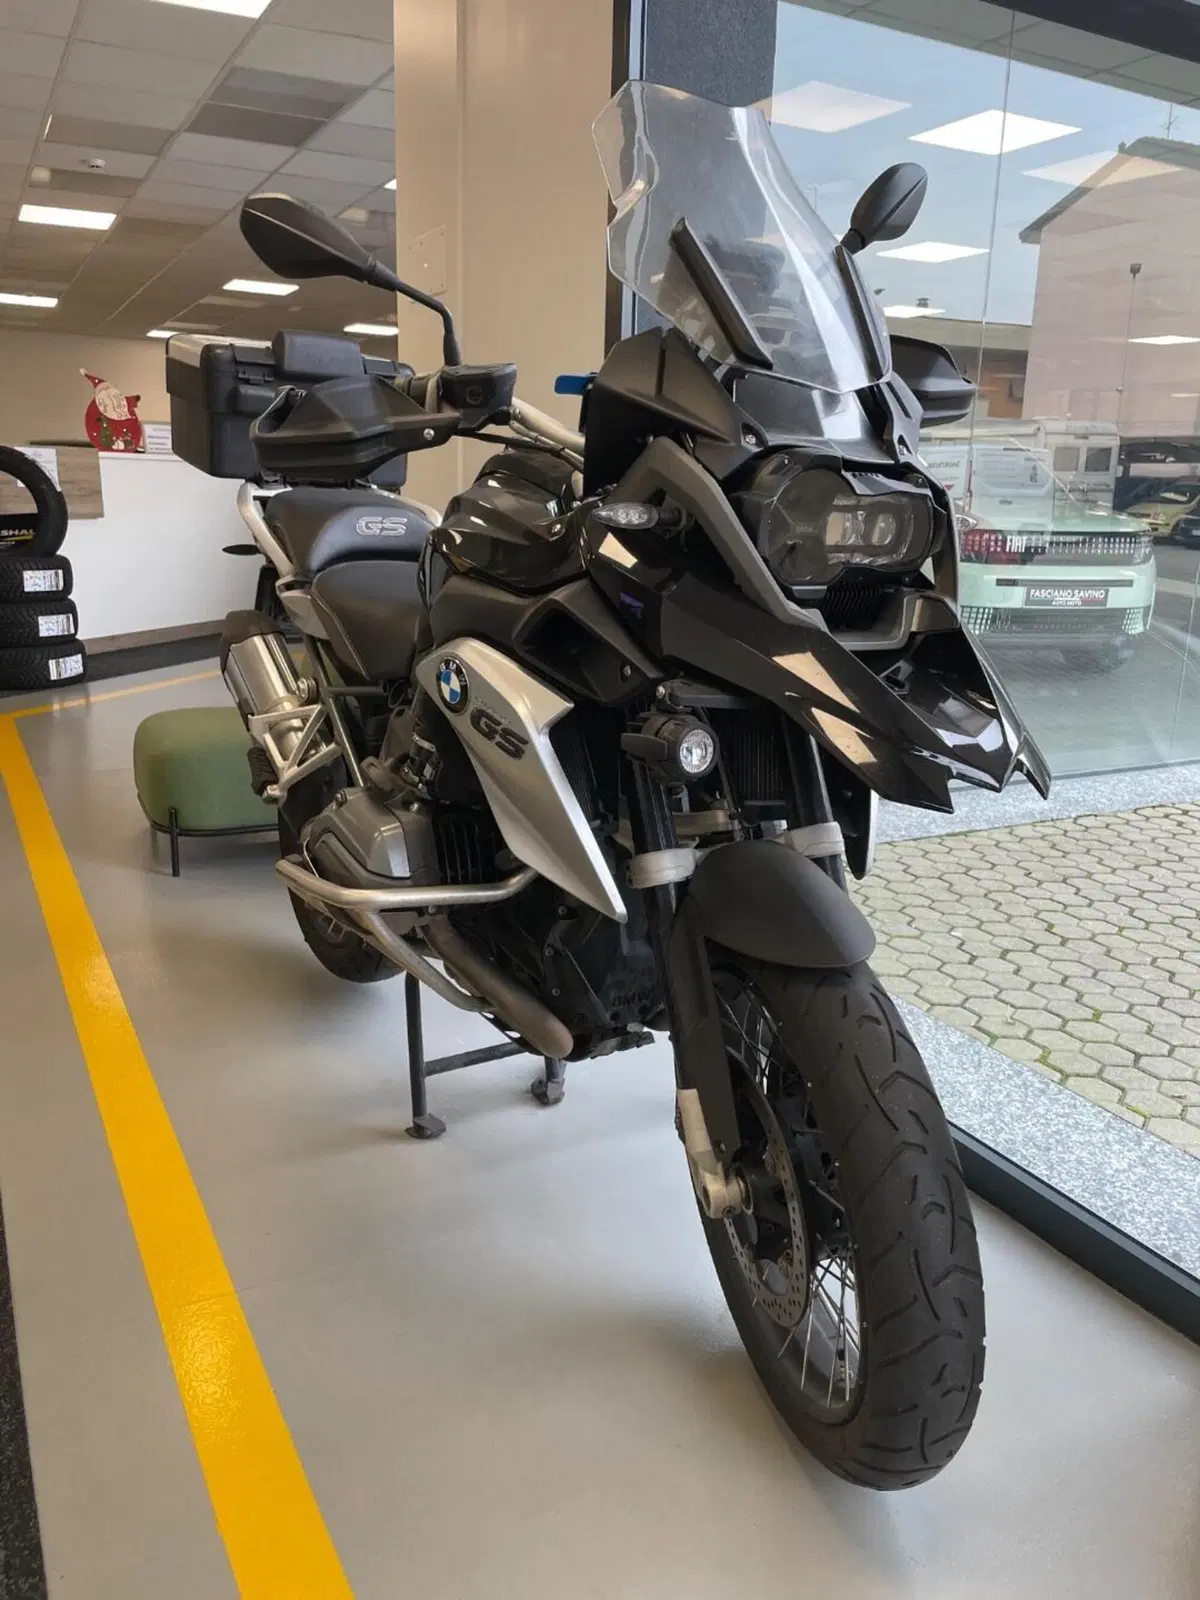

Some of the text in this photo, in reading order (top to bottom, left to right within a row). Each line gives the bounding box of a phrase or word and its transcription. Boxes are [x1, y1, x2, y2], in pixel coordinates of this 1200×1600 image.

[355, 516, 408, 537] GS
[1006, 535, 1028, 553] FIAT
[1030, 588, 1106, 599] FASCIANO SAVINO
[469, 708, 529, 761] GS
